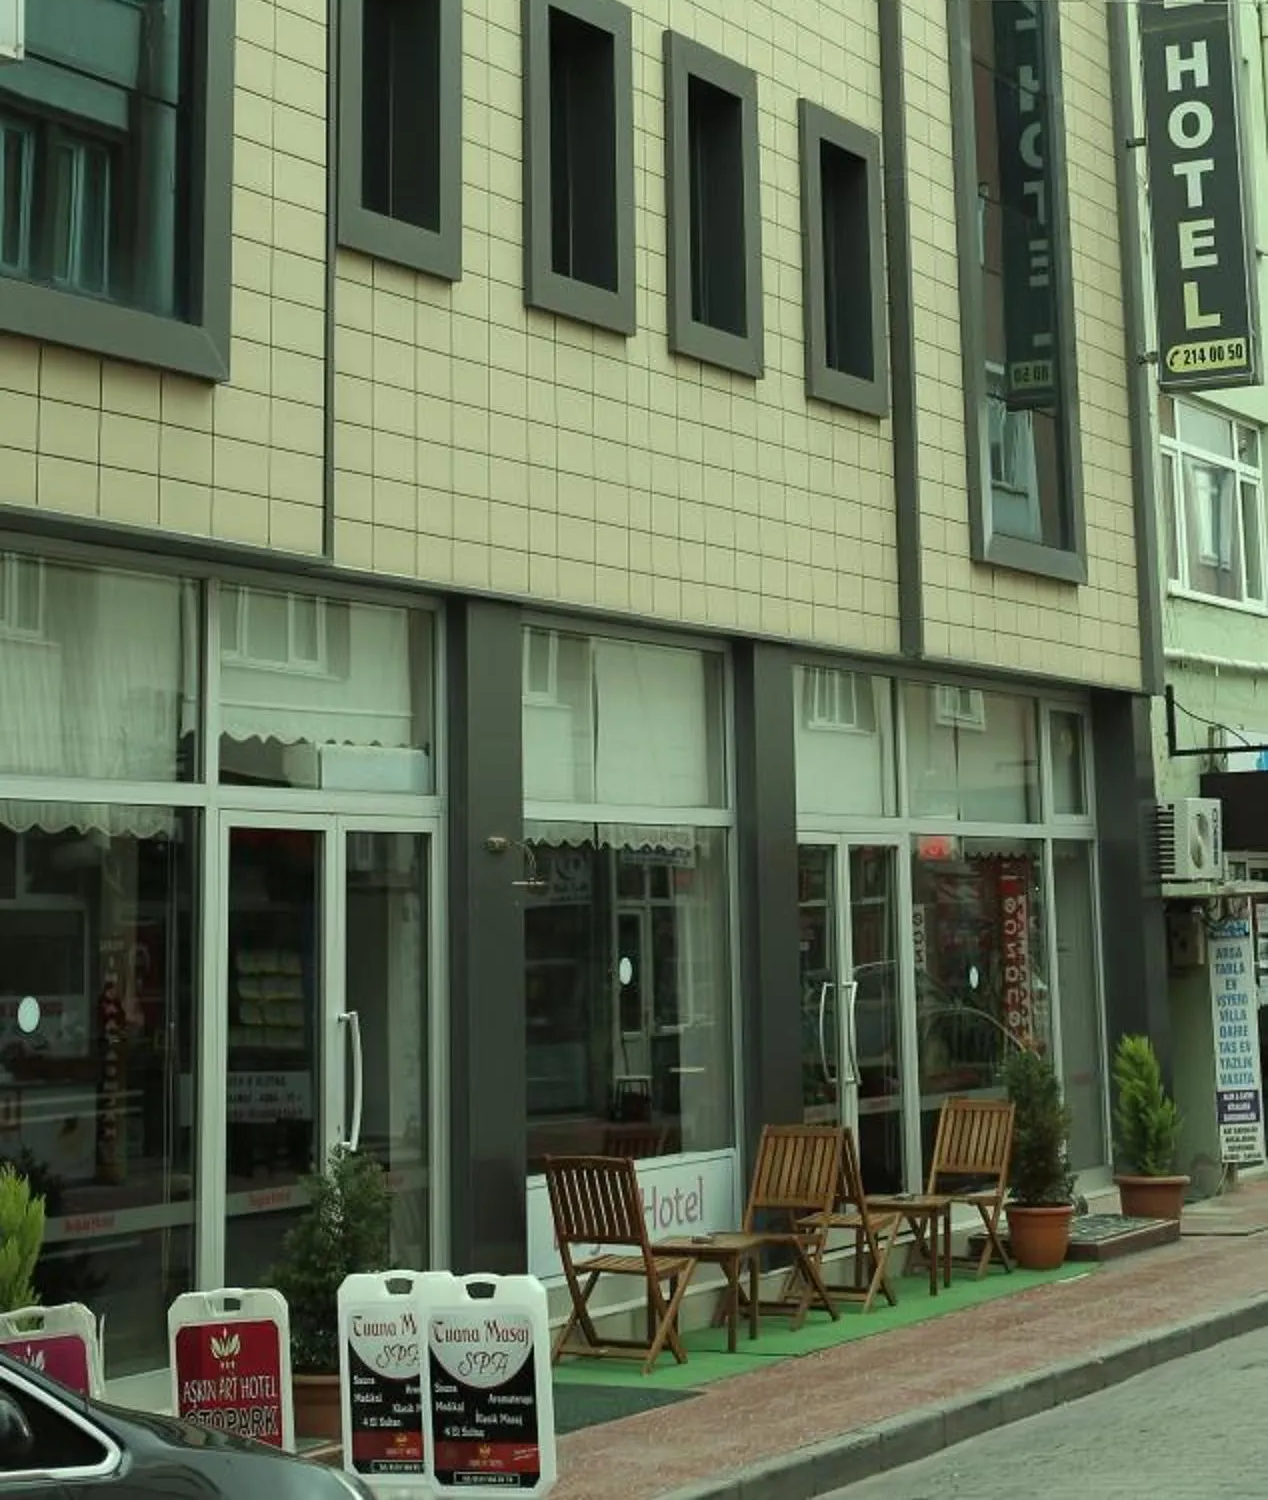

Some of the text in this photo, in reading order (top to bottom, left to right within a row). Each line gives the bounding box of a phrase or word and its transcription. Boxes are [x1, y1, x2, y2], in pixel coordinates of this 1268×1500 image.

[1165, 39, 1222, 330] HOTEL
[1184, 343, 1243, 365] 214 00 50
[637, 1175, 704, 1231] Hotel
[352, 1315, 396, 1337] Tuana
[431, 1321, 480, 1343] Tuana
[484, 1319, 530, 1347] Masaj
[457, 1351, 510, 1376] SPA
[219, 1376, 238, 1401] ART
[240, 1374, 279, 1399] HOTEL
